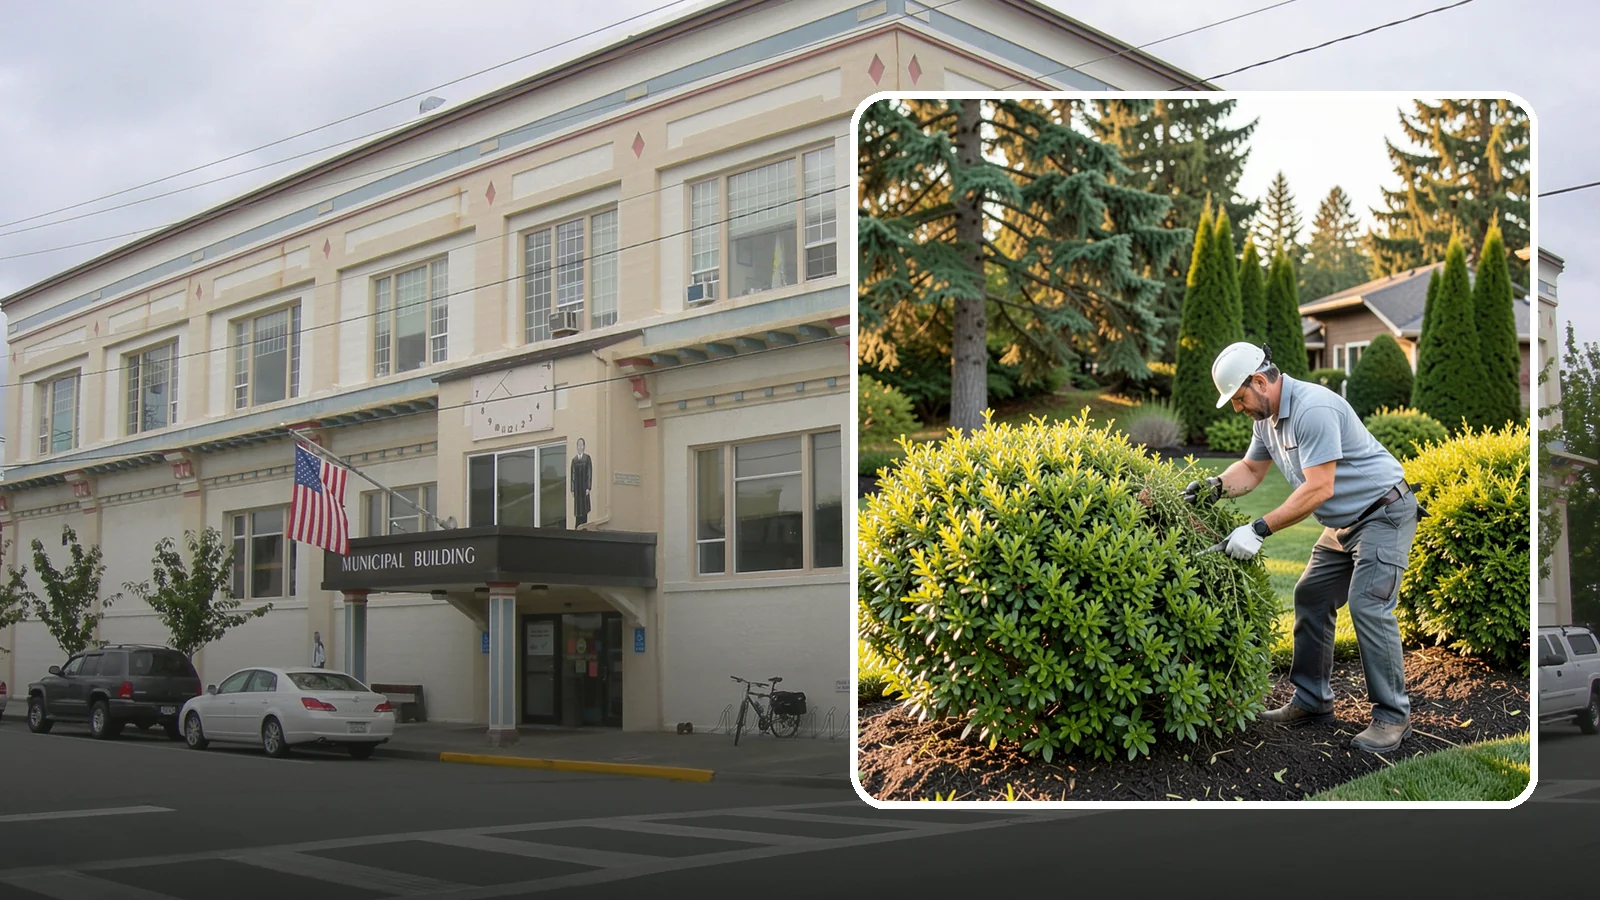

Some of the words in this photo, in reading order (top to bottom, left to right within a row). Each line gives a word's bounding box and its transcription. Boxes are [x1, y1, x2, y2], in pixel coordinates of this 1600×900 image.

[476, 390, 479, 398] 7
[536, 402, 540, 410] 4
[481, 407, 485, 415] 8
[529, 414, 533, 422] 3
[507, 425, 513, 433] 12
[521, 420, 525, 428] 2
[342, 552, 405, 572] MUNICIPAL
[414, 546, 475, 567] BUILDING
